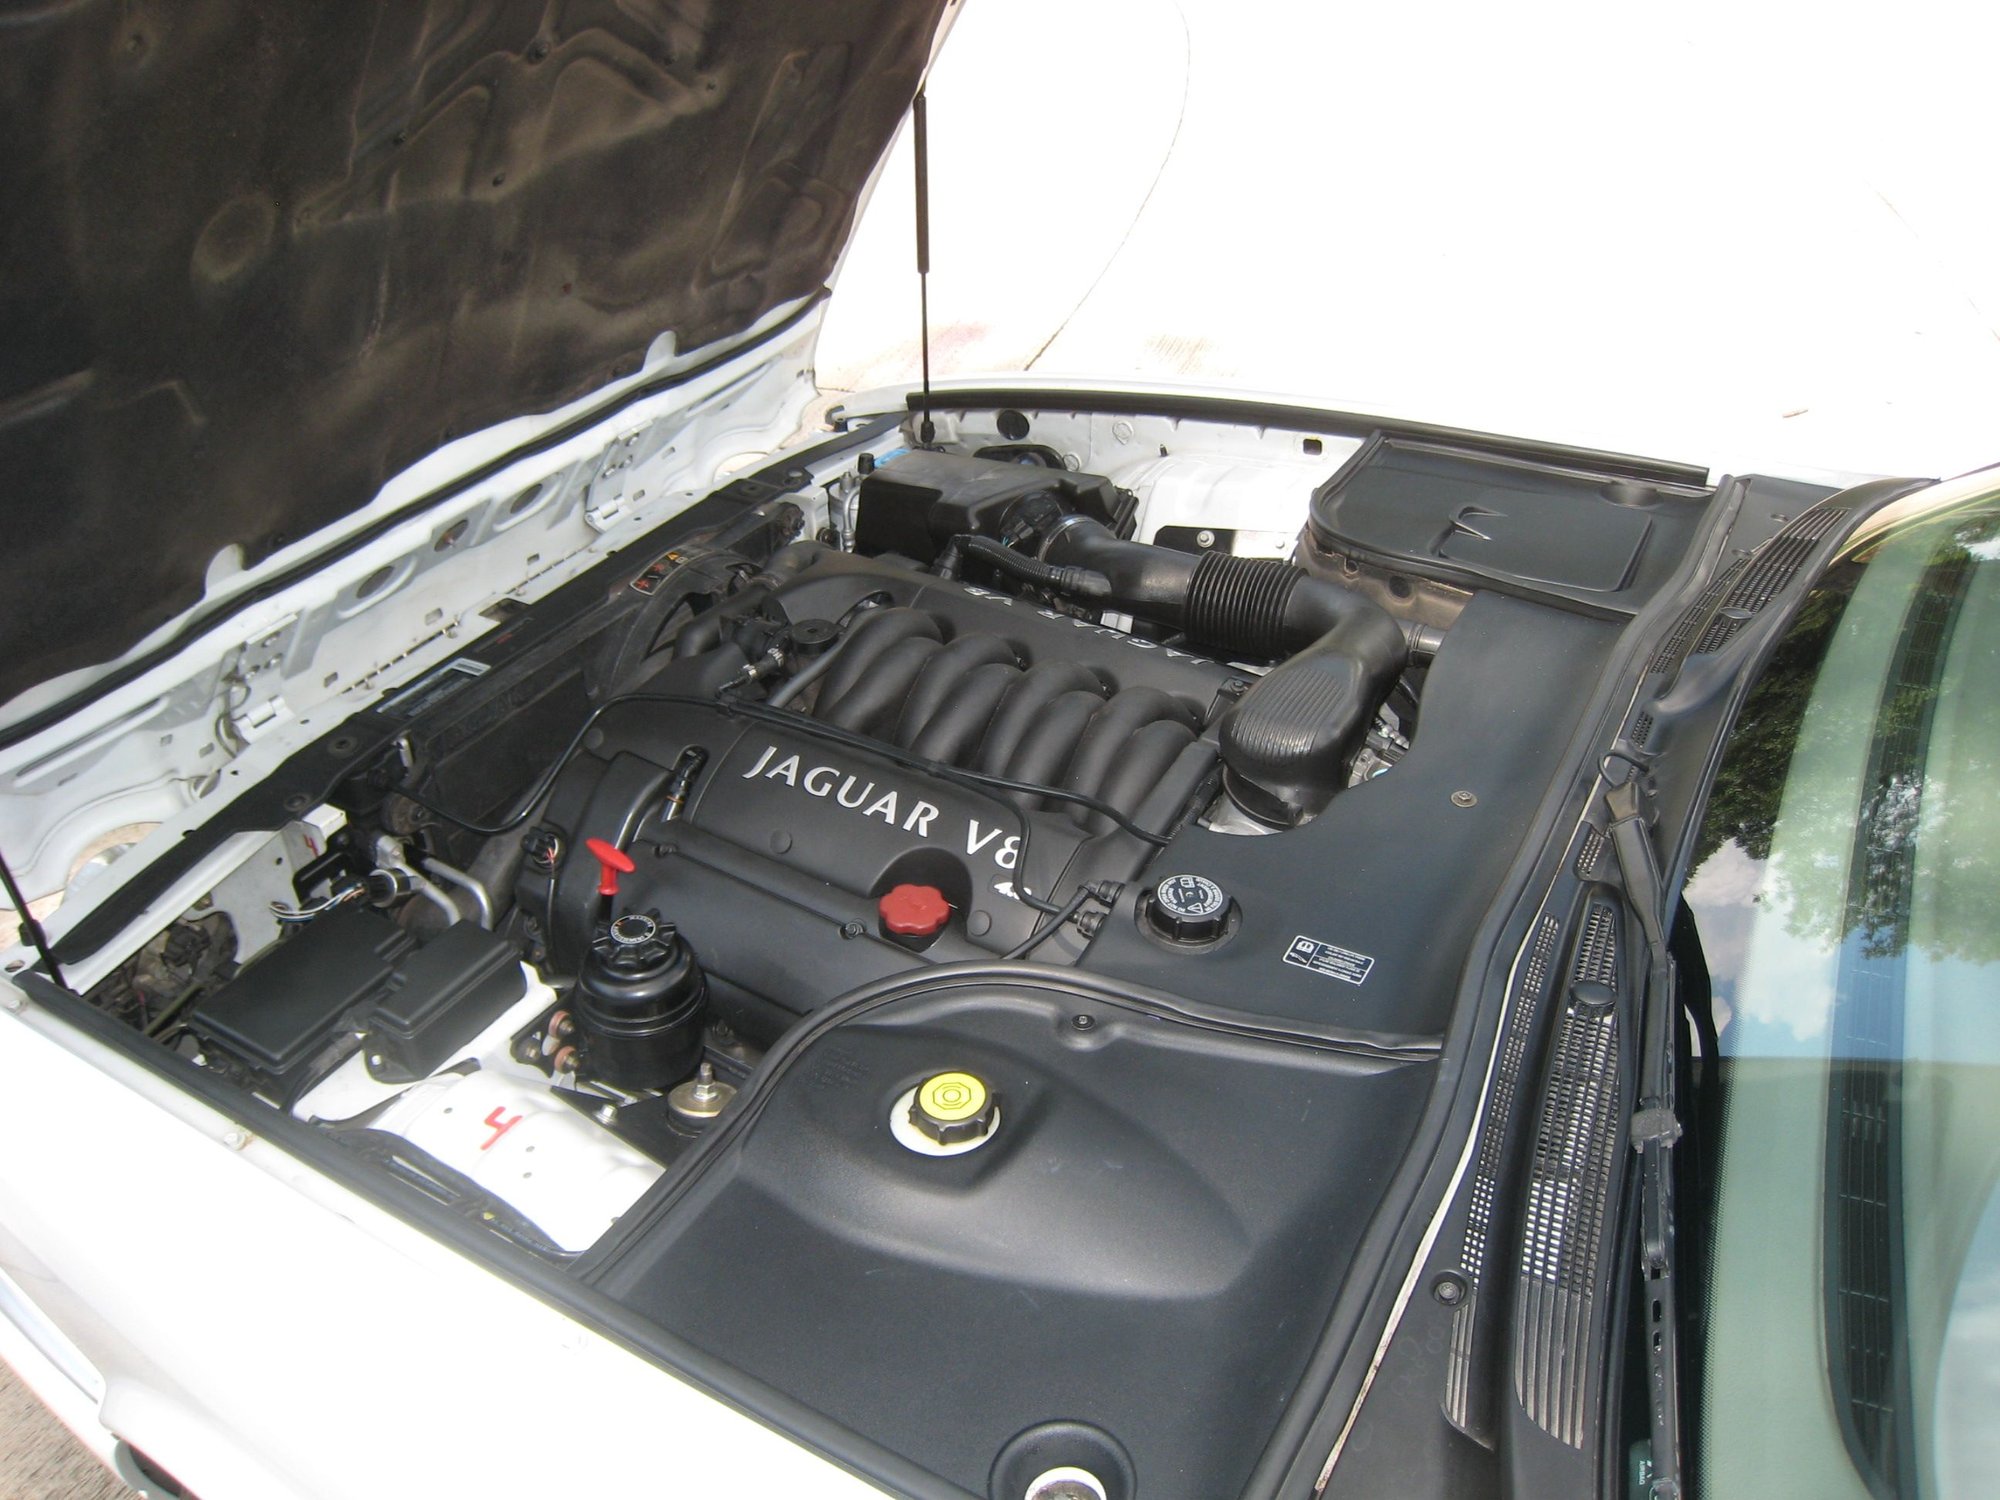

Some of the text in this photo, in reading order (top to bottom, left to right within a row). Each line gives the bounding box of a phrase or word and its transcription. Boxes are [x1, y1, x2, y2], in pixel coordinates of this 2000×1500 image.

[742, 746, 1021, 869] JAGUAR V8
[480, 1106, 523, 1151] 4
